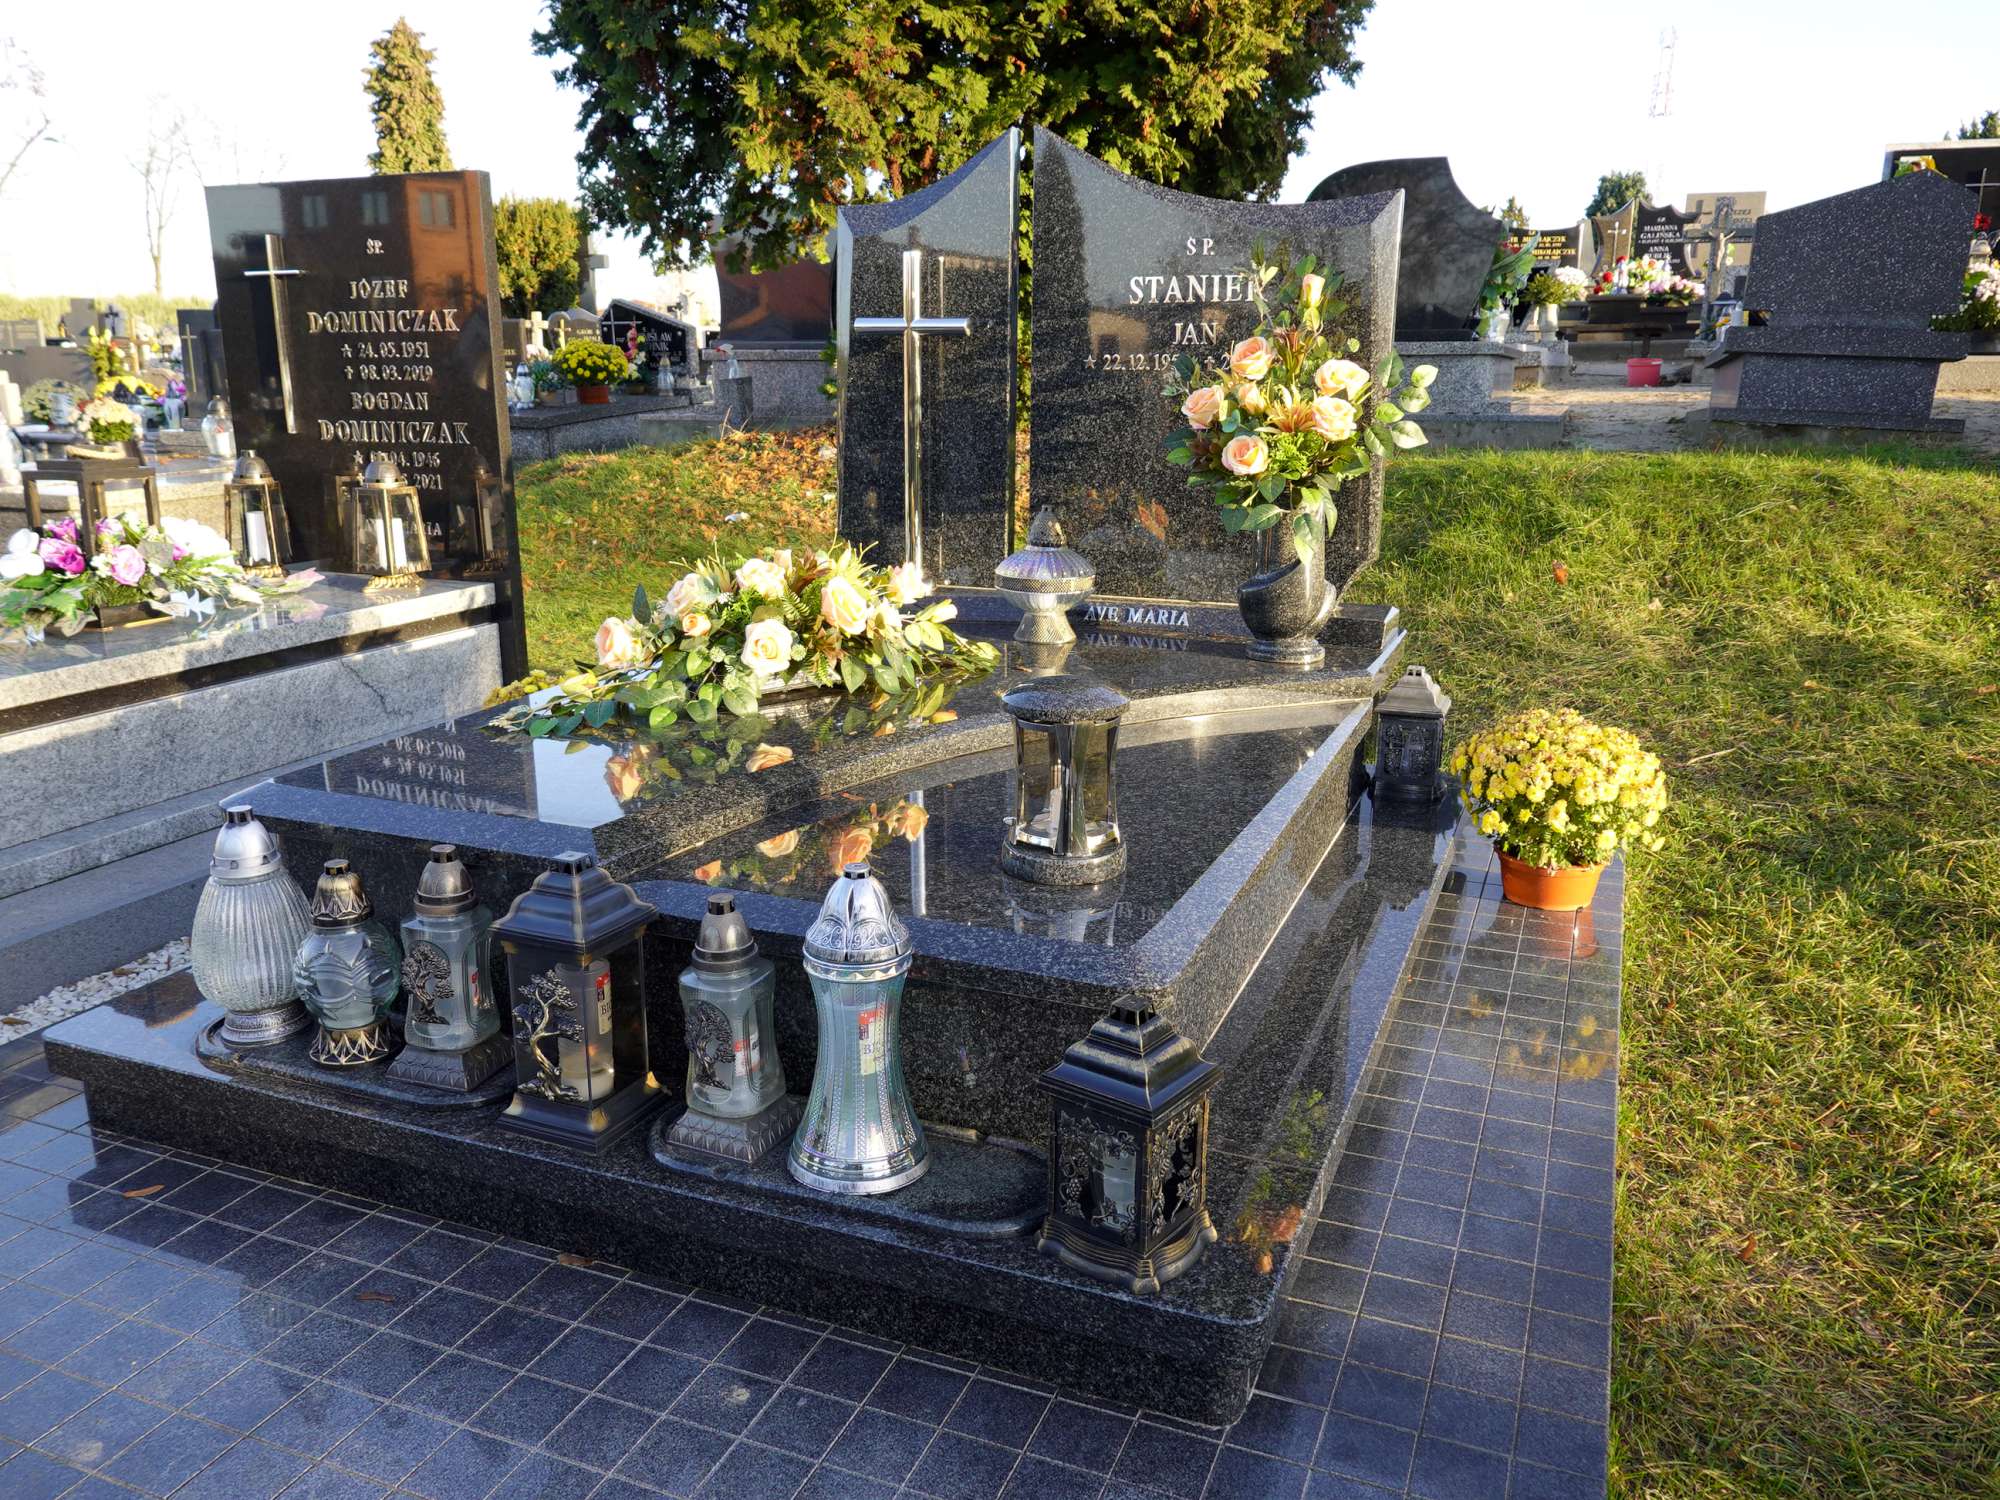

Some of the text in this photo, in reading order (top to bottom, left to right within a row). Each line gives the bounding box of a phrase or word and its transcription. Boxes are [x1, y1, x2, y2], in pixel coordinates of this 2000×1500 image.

[349, 277, 408, 300] JÓZEF
[306, 308, 461, 335] DOMINICZAK
[1172, 322, 1218, 346] JAN
[351, 391, 429, 412] BOGDAN
[318, 419, 471, 446] DOMINICZAK
[1084, 605, 1190, 628] AVE MARIA
